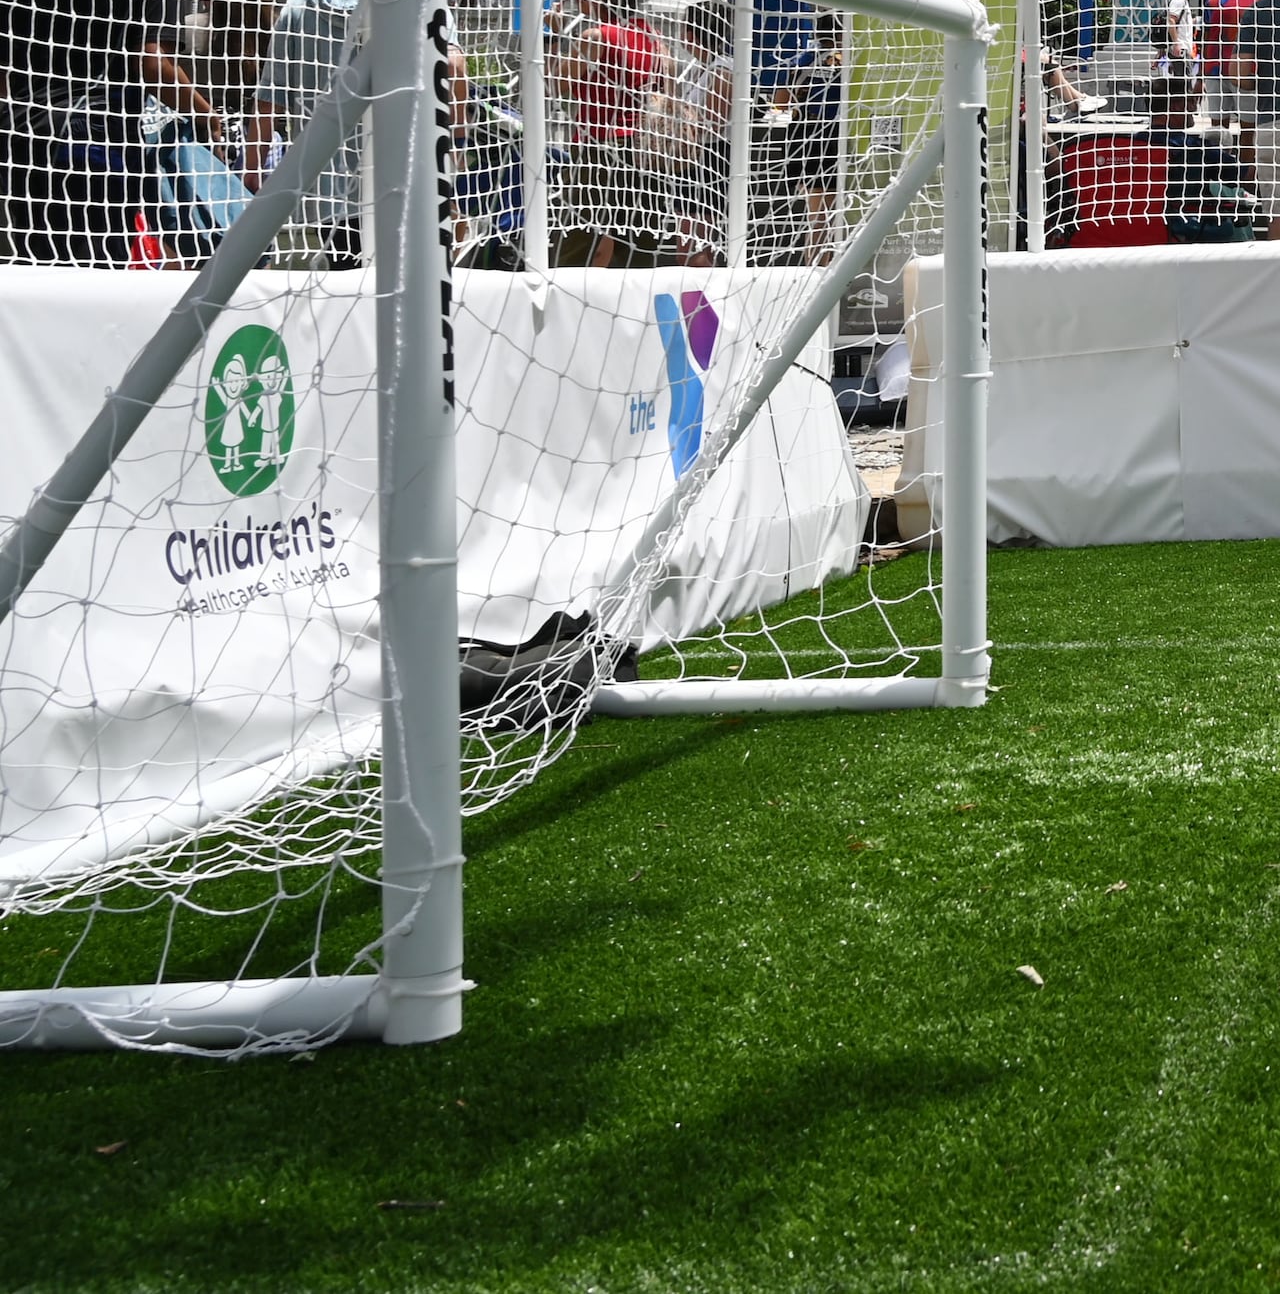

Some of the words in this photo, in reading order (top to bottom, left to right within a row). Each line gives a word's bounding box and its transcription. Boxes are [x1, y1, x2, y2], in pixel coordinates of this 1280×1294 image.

[630, 391, 656, 435] the
[165, 502, 336, 585] Children's
[272, 572, 288, 590] of
[290, 561, 350, 587] Atlanta
